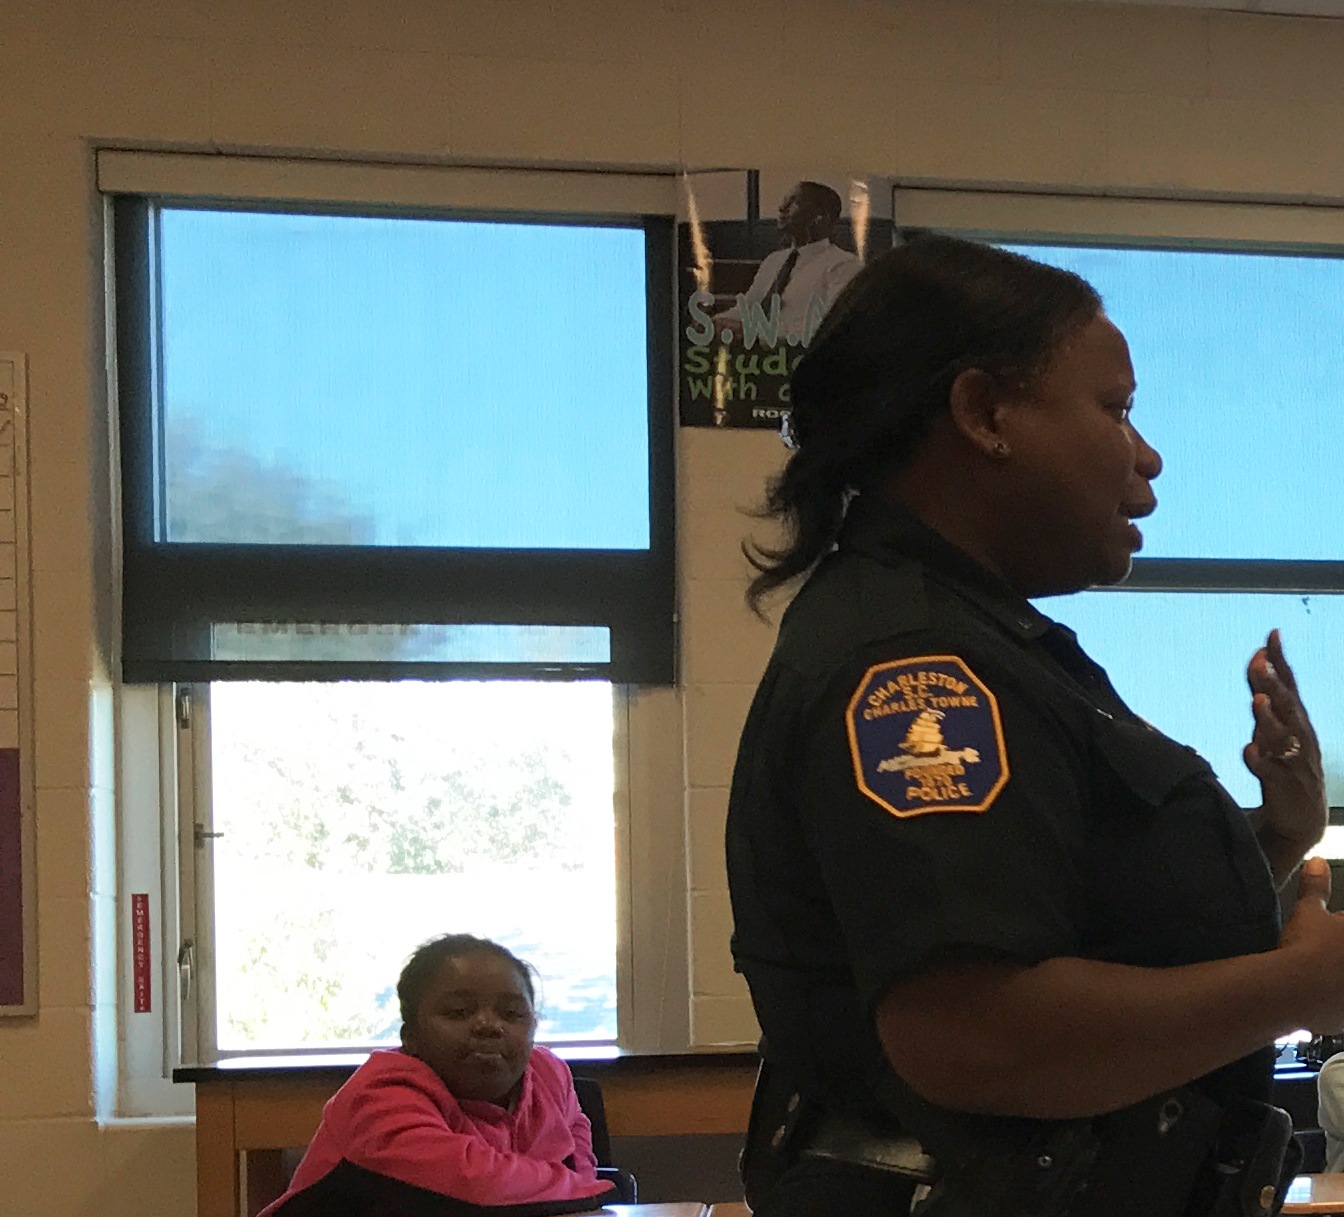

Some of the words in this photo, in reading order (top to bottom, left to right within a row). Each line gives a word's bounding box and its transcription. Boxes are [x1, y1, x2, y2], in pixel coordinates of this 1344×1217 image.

[684, 345, 803, 375] Stud
[867, 671, 970, 706] CHARLESTON
[863, 699, 926, 721] CHARLES
[929, 695, 980, 709] TOWNE
[905, 783, 974, 802] POLICE
